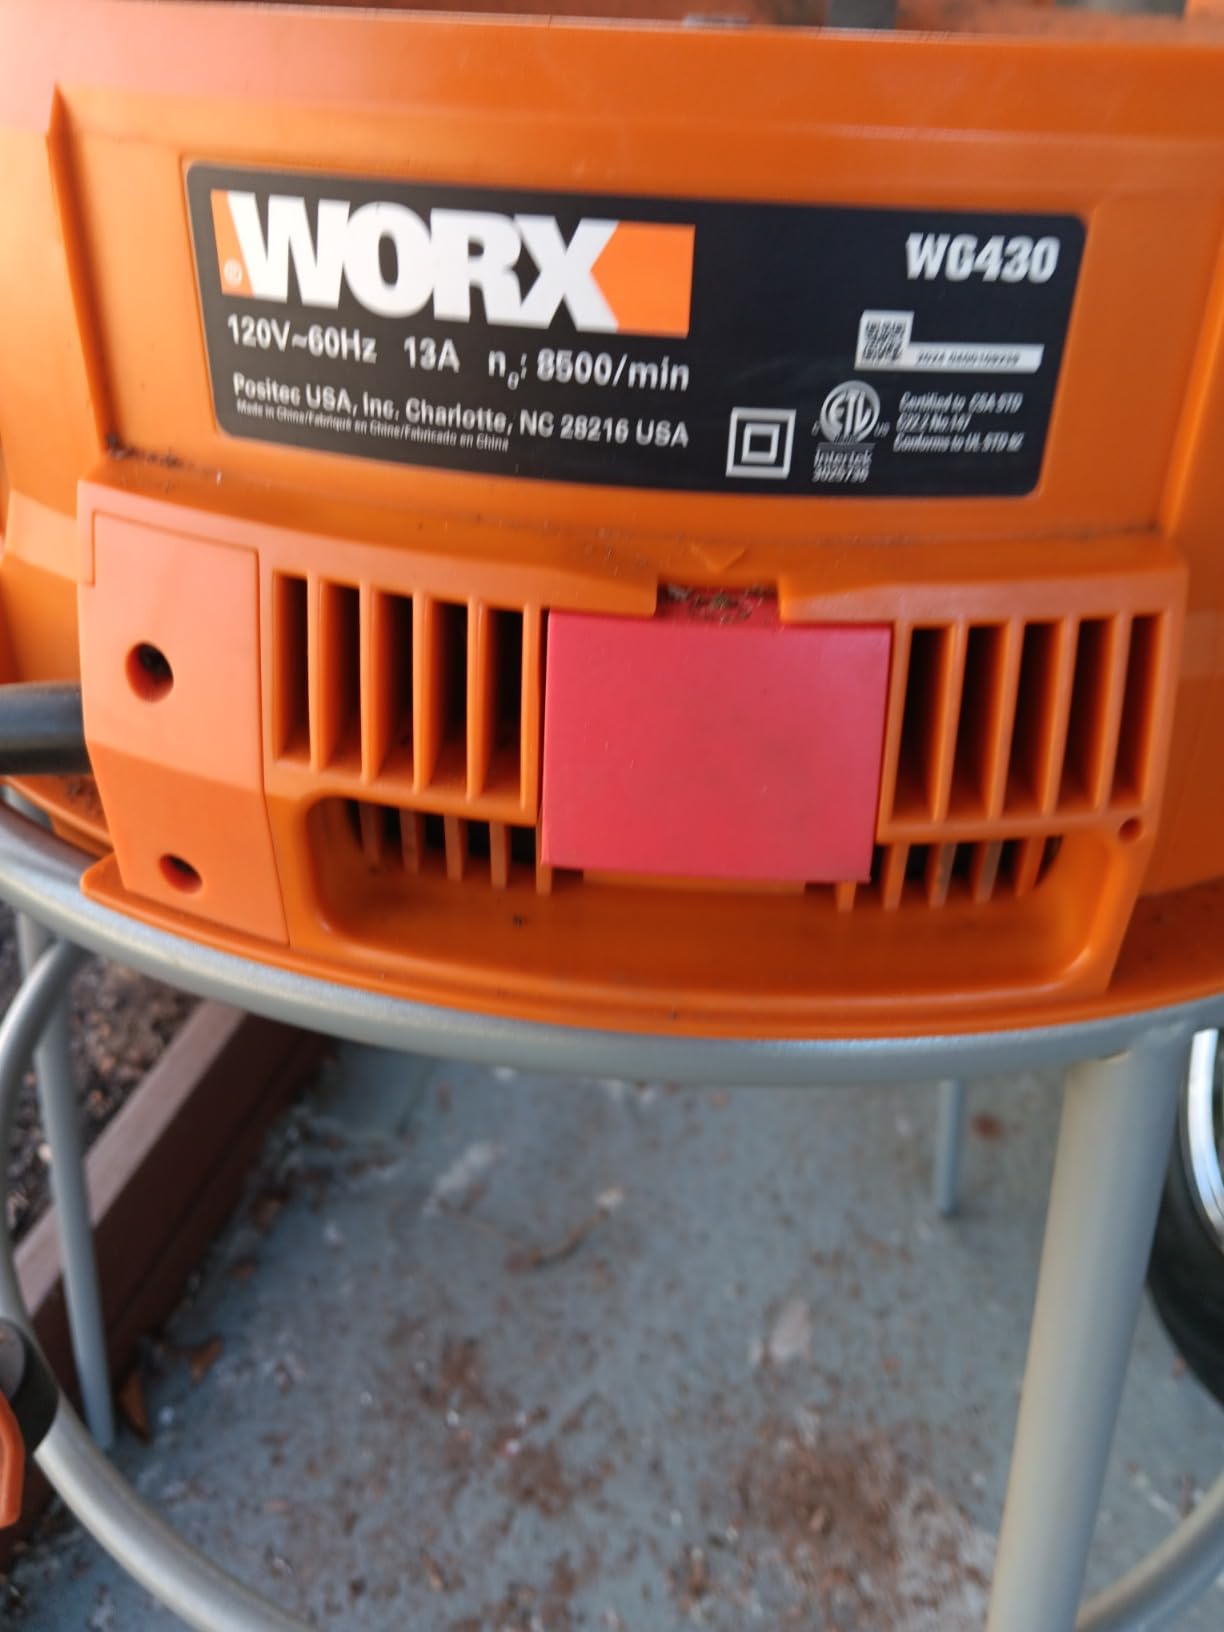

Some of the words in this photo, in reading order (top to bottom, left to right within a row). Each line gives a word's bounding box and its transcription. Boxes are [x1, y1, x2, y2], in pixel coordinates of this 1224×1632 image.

[226, 190, 619, 333] WORX
[906, 232, 1061, 283] WG430
[227, 314, 377, 364] 120V~60Hz
[404, 336, 460, 373] 13A
[537, 349, 690, 390] 8500/min
[233, 372, 301, 406] Positec
[306, 383, 358, 416] USA,
[405, 396, 513, 436] Charlotte,
[519, 408, 555, 438] NC
[560, 412, 629, 444] 28216
[635, 418, 689, 448] USA
